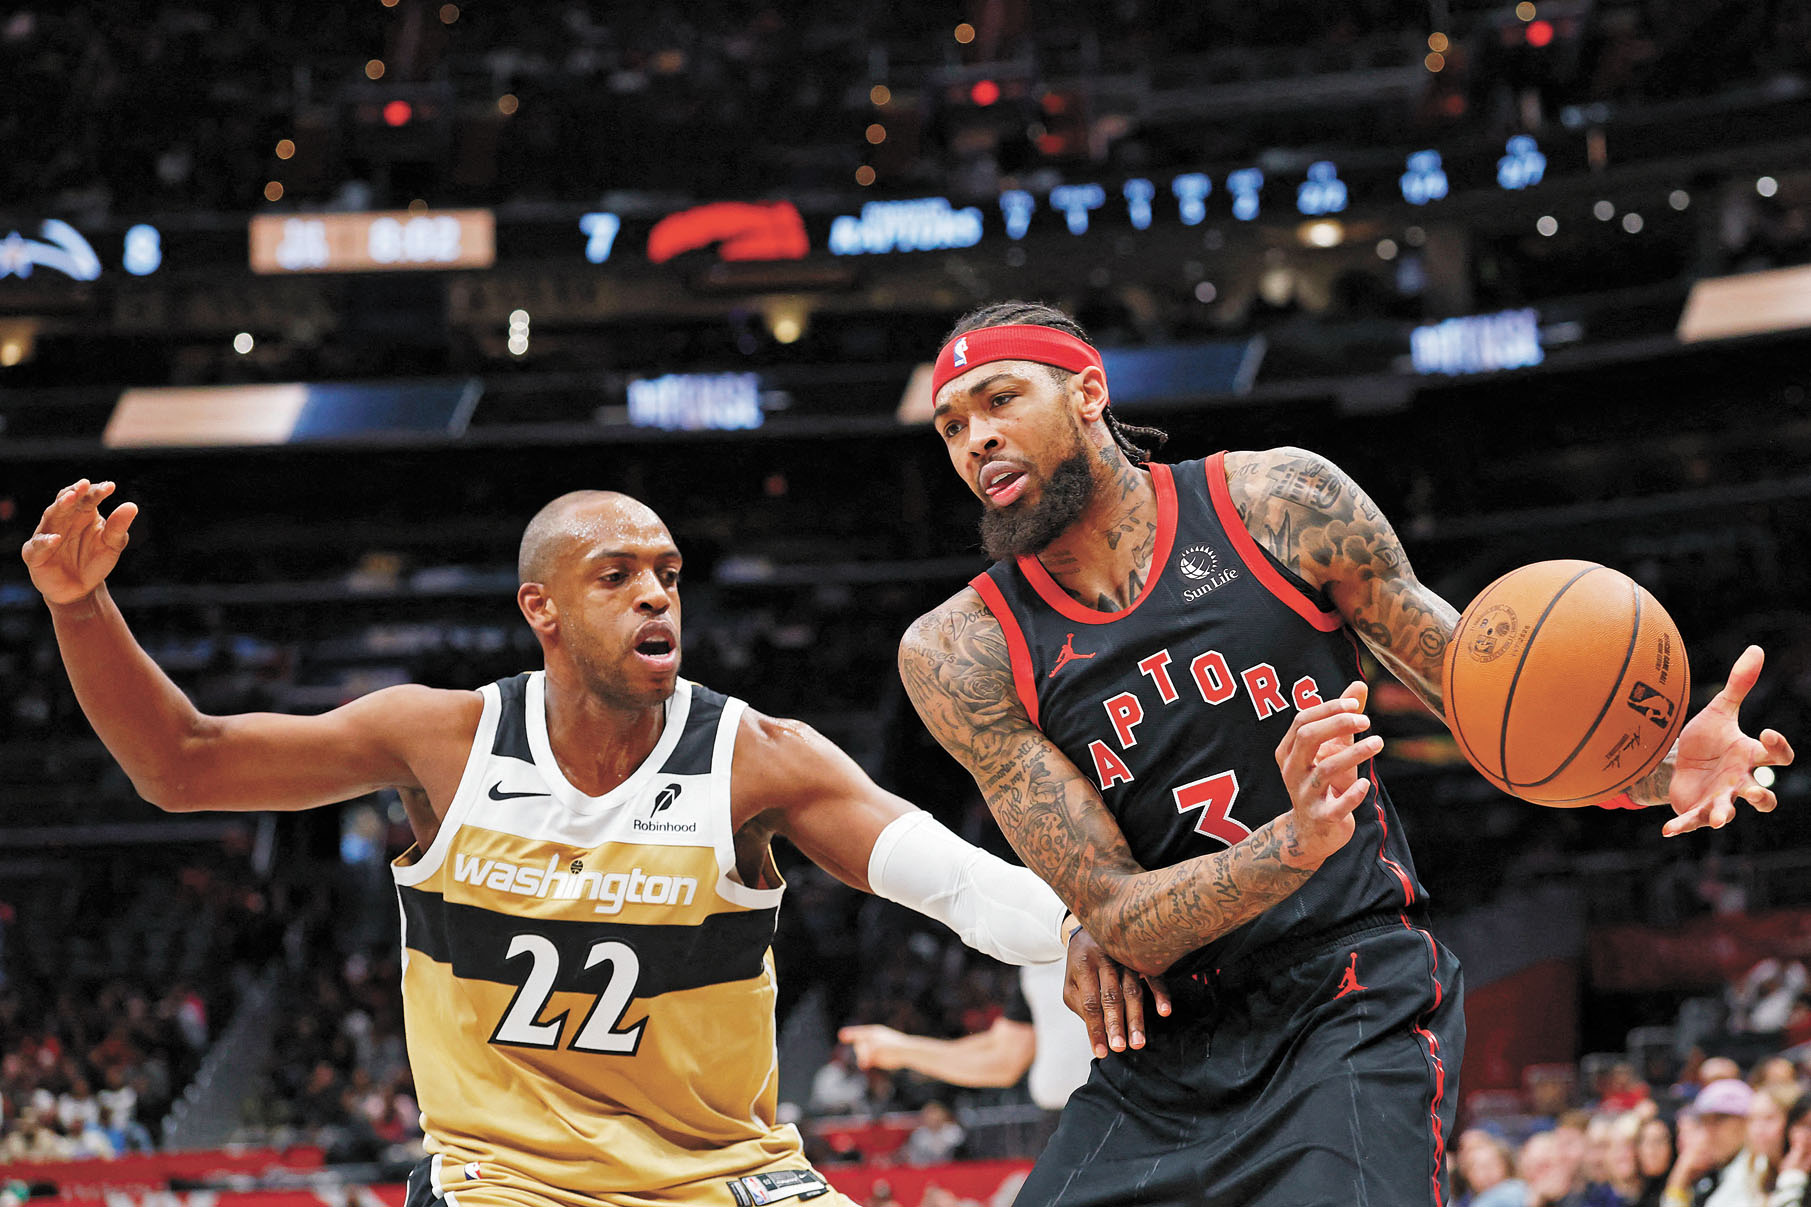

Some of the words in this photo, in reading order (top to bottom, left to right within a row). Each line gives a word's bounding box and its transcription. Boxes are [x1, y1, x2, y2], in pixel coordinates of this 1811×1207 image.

[1183, 584, 1212, 602] Sun
[1210, 568, 1239, 588] Life
[1088, 648, 1323, 791] APTORS
[633, 819, 697, 832] Robinhood
[1172, 769, 1253, 848] 3
[454, 853, 698, 915] washington
[488, 933, 649, 1056] 22
